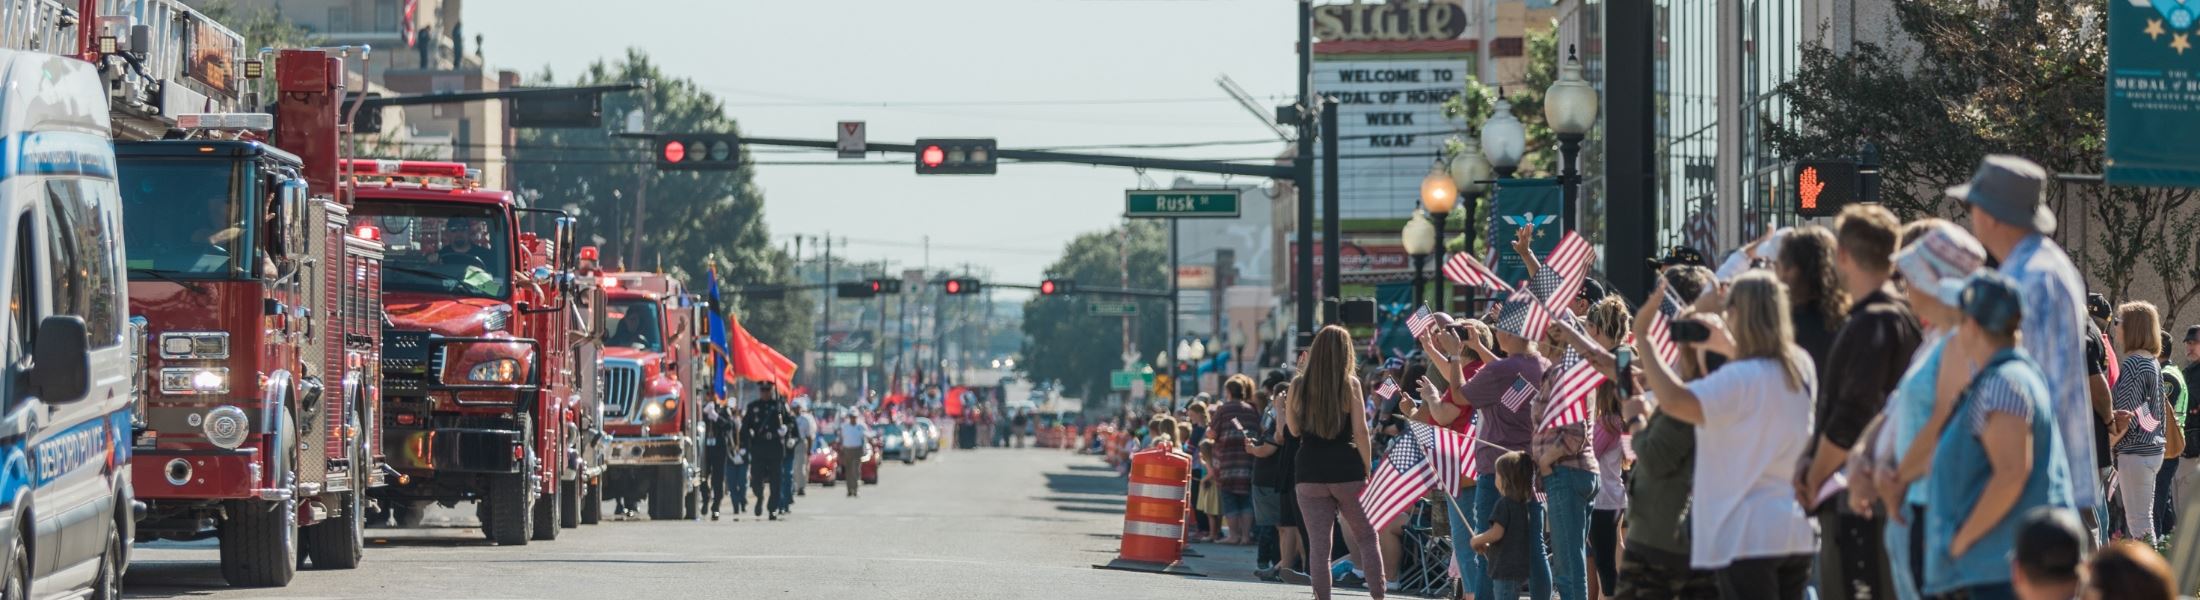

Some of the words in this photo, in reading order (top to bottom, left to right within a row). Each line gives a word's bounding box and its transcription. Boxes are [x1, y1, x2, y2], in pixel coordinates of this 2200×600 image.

[1339, 69, 1420, 82] WELCOME
[1432, 69, 1453, 81] TO
[2115, 78, 2167, 90] MEDAL
[1379, 91, 1399, 104] OF
[1365, 112, 1414, 126] WEEK
[1369, 134, 1416, 147] KGAF
[1156, 195, 1195, 211] Rusk
[40, 433, 80, 480] BEDFORD
